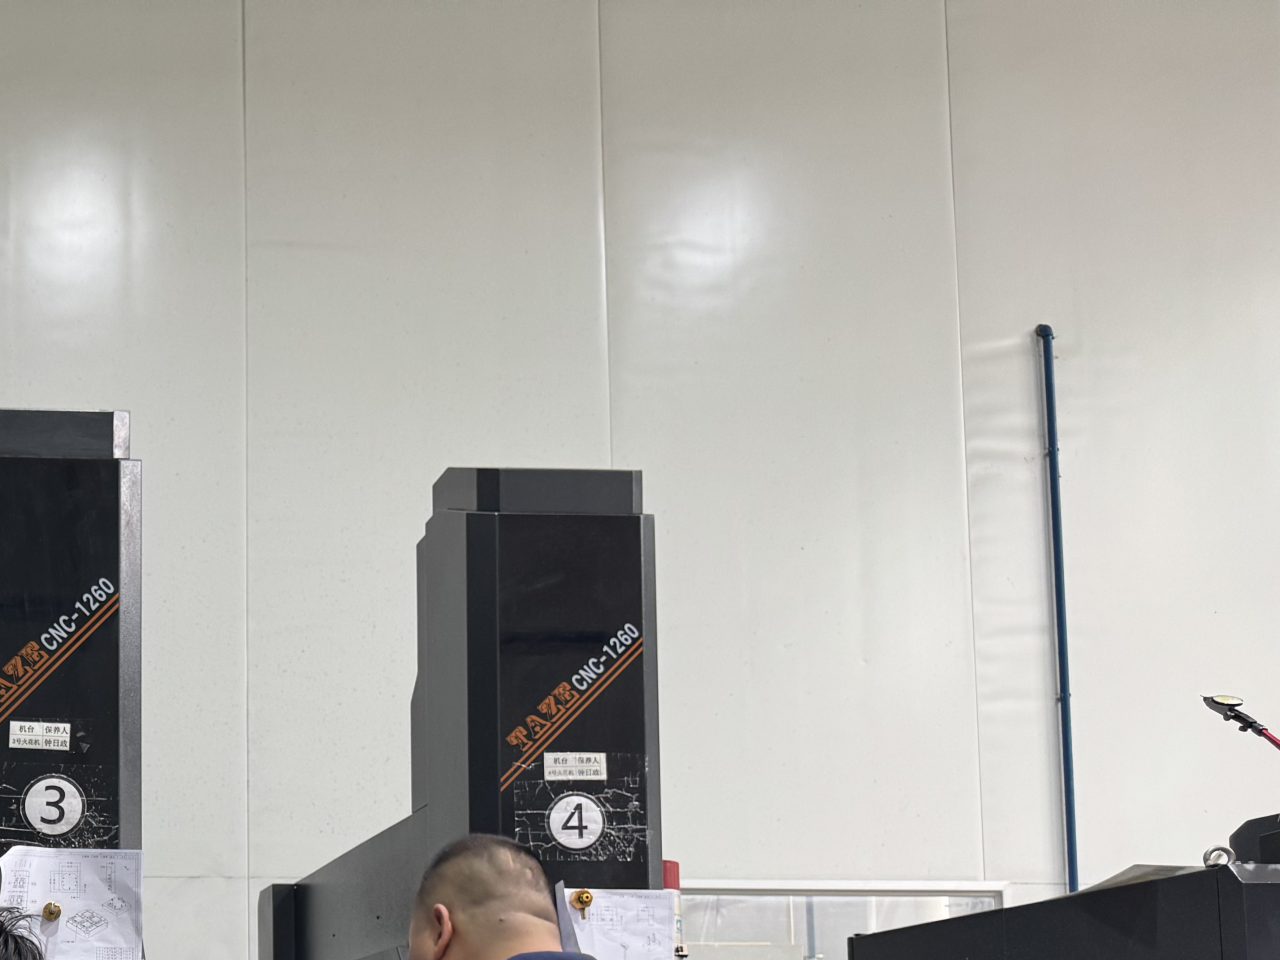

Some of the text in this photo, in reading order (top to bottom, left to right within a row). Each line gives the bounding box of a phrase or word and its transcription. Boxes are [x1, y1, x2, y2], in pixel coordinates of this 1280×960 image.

[40, 577, 115, 651] CNC-1260
[505, 623, 640, 752] TAZE CNC-1260
[19, 724, 35, 734] 机台
[40, 785, 66, 825] 3
[561, 803, 588, 839] 4
